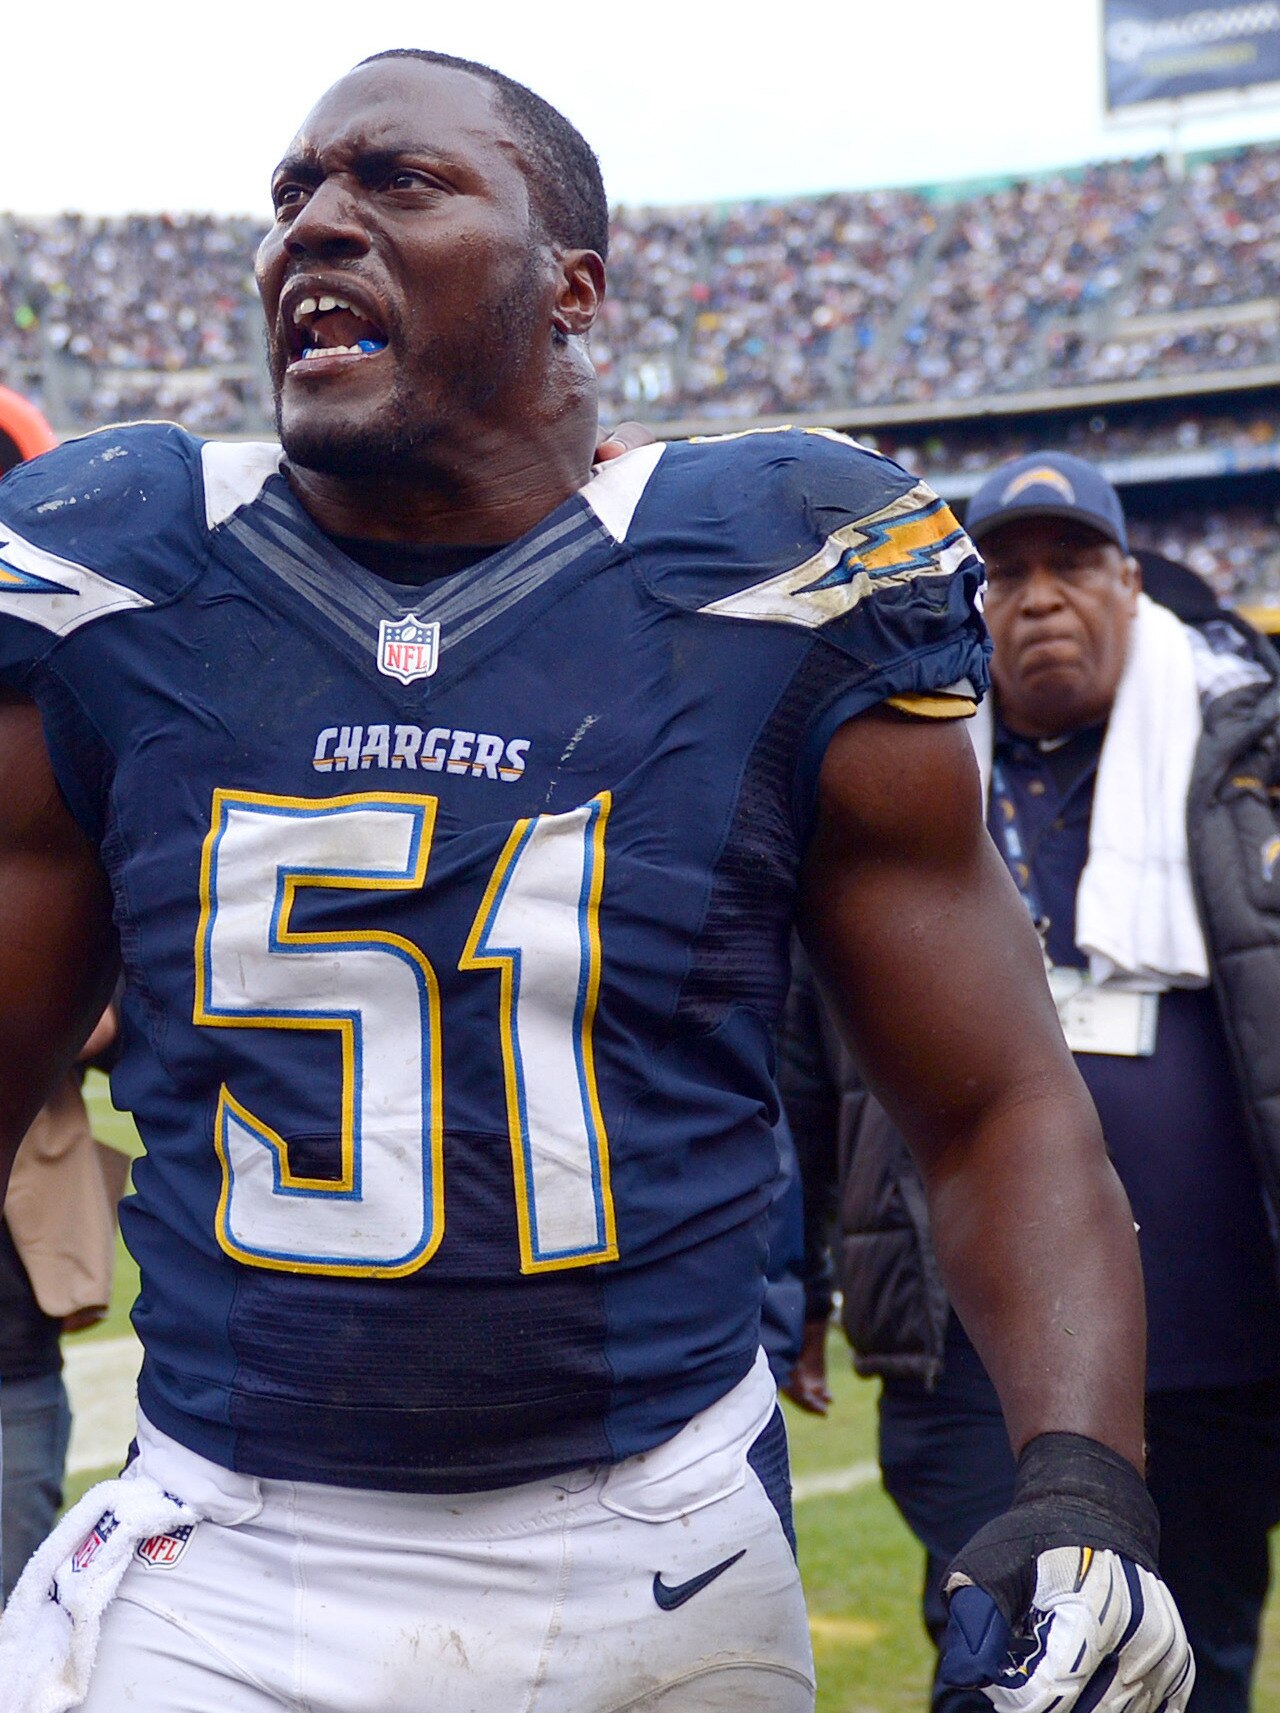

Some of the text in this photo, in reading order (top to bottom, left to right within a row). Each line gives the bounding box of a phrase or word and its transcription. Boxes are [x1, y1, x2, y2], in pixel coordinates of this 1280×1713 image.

[386, 643, 428, 672] NFL
[312, 724, 531, 782] CHARGERS
[193, 787, 619, 1279] 51
[141, 1534, 177, 1561] NFL
